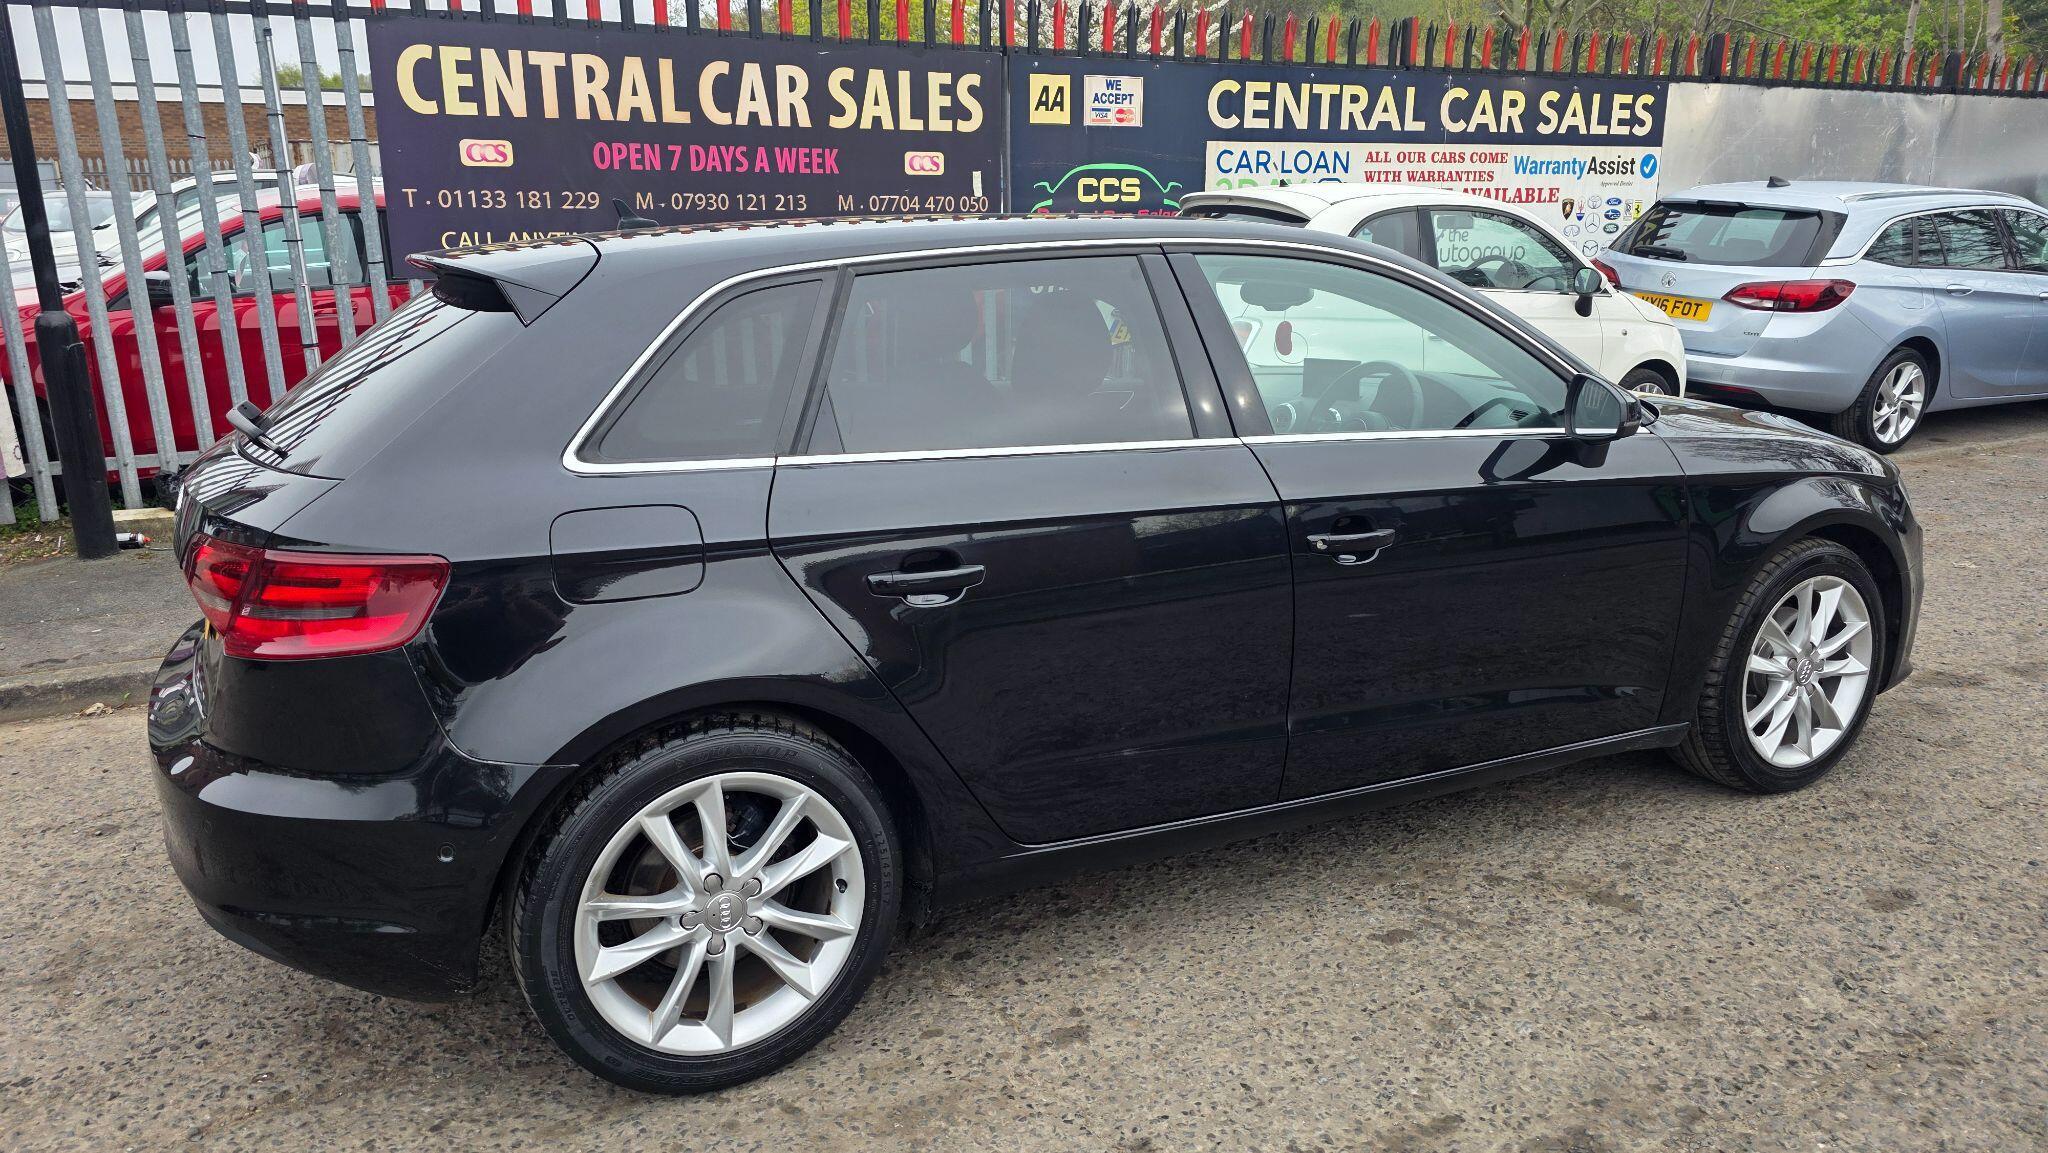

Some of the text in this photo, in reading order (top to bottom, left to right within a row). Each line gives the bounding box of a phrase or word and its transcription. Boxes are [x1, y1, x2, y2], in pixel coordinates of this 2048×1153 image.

[396, 43, 984, 133] CENTRAL CAR SALES
[1105, 78, 1122, 91] WE
[1034, 85, 1065, 112] AA
[1092, 92, 1134, 105] ACCEPT
[1207, 79, 1655, 137] CENTRAL CAR SALES
[592, 141, 840, 174] OPEN 7 DAYS A WEEK
[1216, 149, 1350, 174] CAR LOAN
[1365, 151, 1508, 164] ALL OUR CARS COME
[1364, 170, 1495, 183] WITH WARRANTIES
[437, 189, 507, 209] 01133
[516, 190, 552, 209] 181
[561, 191, 600, 210] 229
[1077, 177, 1141, 203] CCS
[671, 192, 730, 211] 07930
[737, 193, 766, 211] 121
[775, 194, 807, 211] 213
[869, 195, 920, 212] 07704
[925, 196, 955, 212] 470
[960, 196, 989, 212] 050
[441, 231, 492, 249] CALL
[1448, 228, 1469, 242] the
[1439, 243, 1525, 263] utogroup
[1671, 300, 1703, 317] FOT
